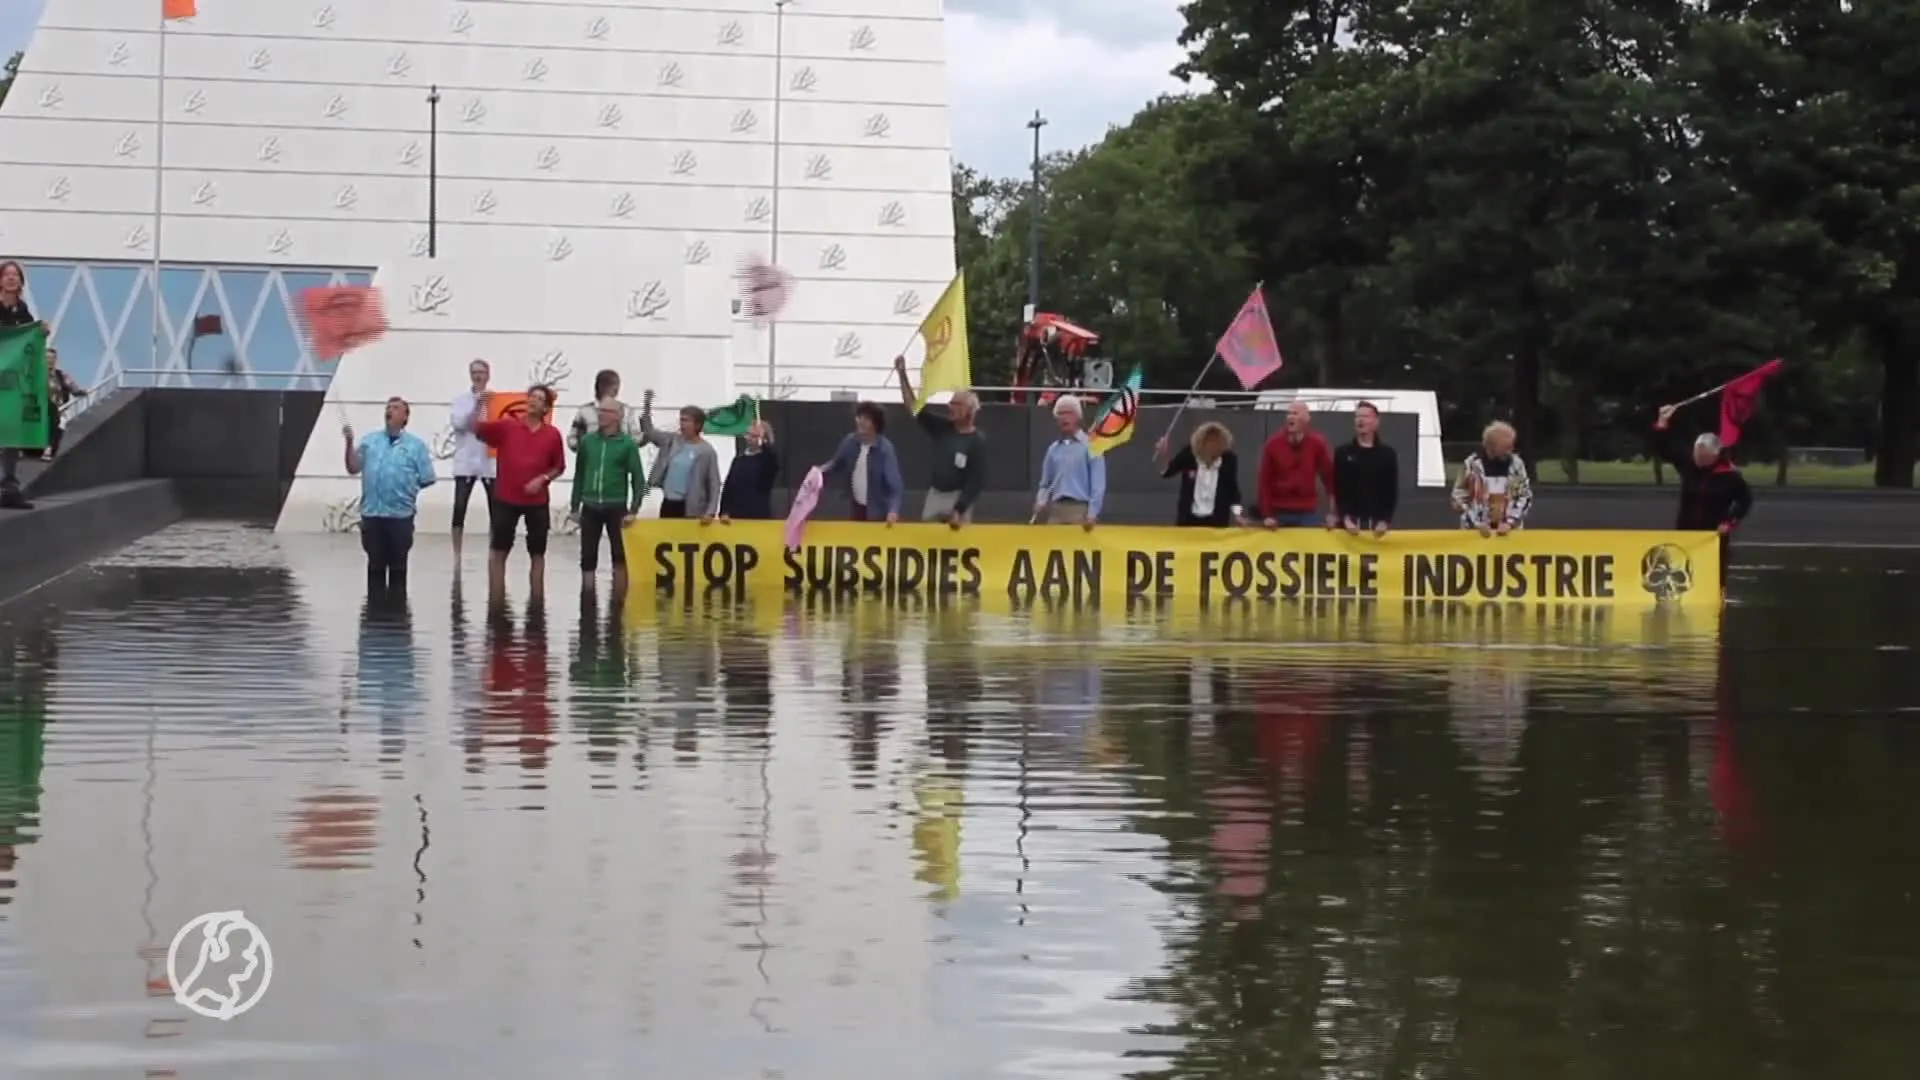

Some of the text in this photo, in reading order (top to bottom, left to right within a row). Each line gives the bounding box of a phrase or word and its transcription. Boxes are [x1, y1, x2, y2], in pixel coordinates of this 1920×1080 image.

[654, 542, 1615, 598] STOP SUBSIDIES AAN DE FOSSIELE INDUSTRIE
